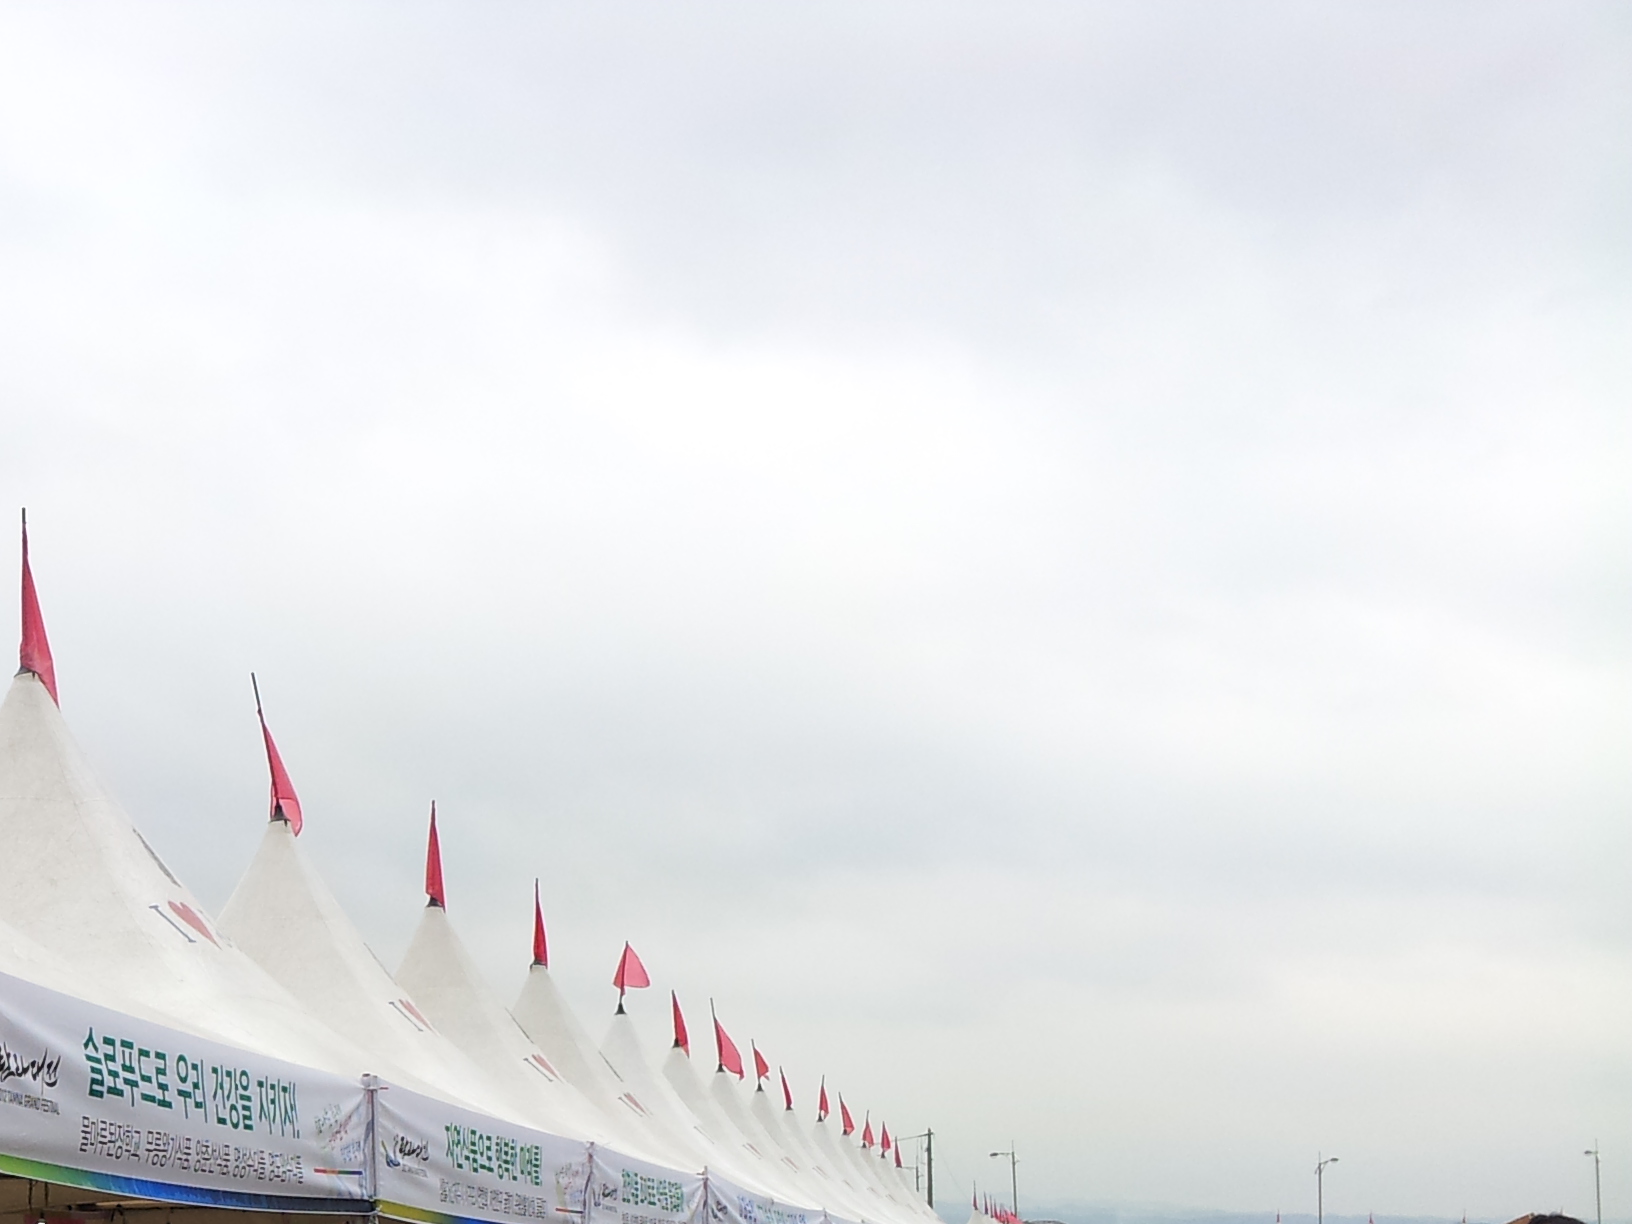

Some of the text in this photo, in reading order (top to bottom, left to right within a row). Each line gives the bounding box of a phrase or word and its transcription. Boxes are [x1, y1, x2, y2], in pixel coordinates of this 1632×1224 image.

[82, 1026, 174, 1111] 슬로푸드로
[175, 1052, 208, 1123] 우리
[212, 1065, 255, 1132] 건강을
[256, 1076, 301, 1139] 지키자!
